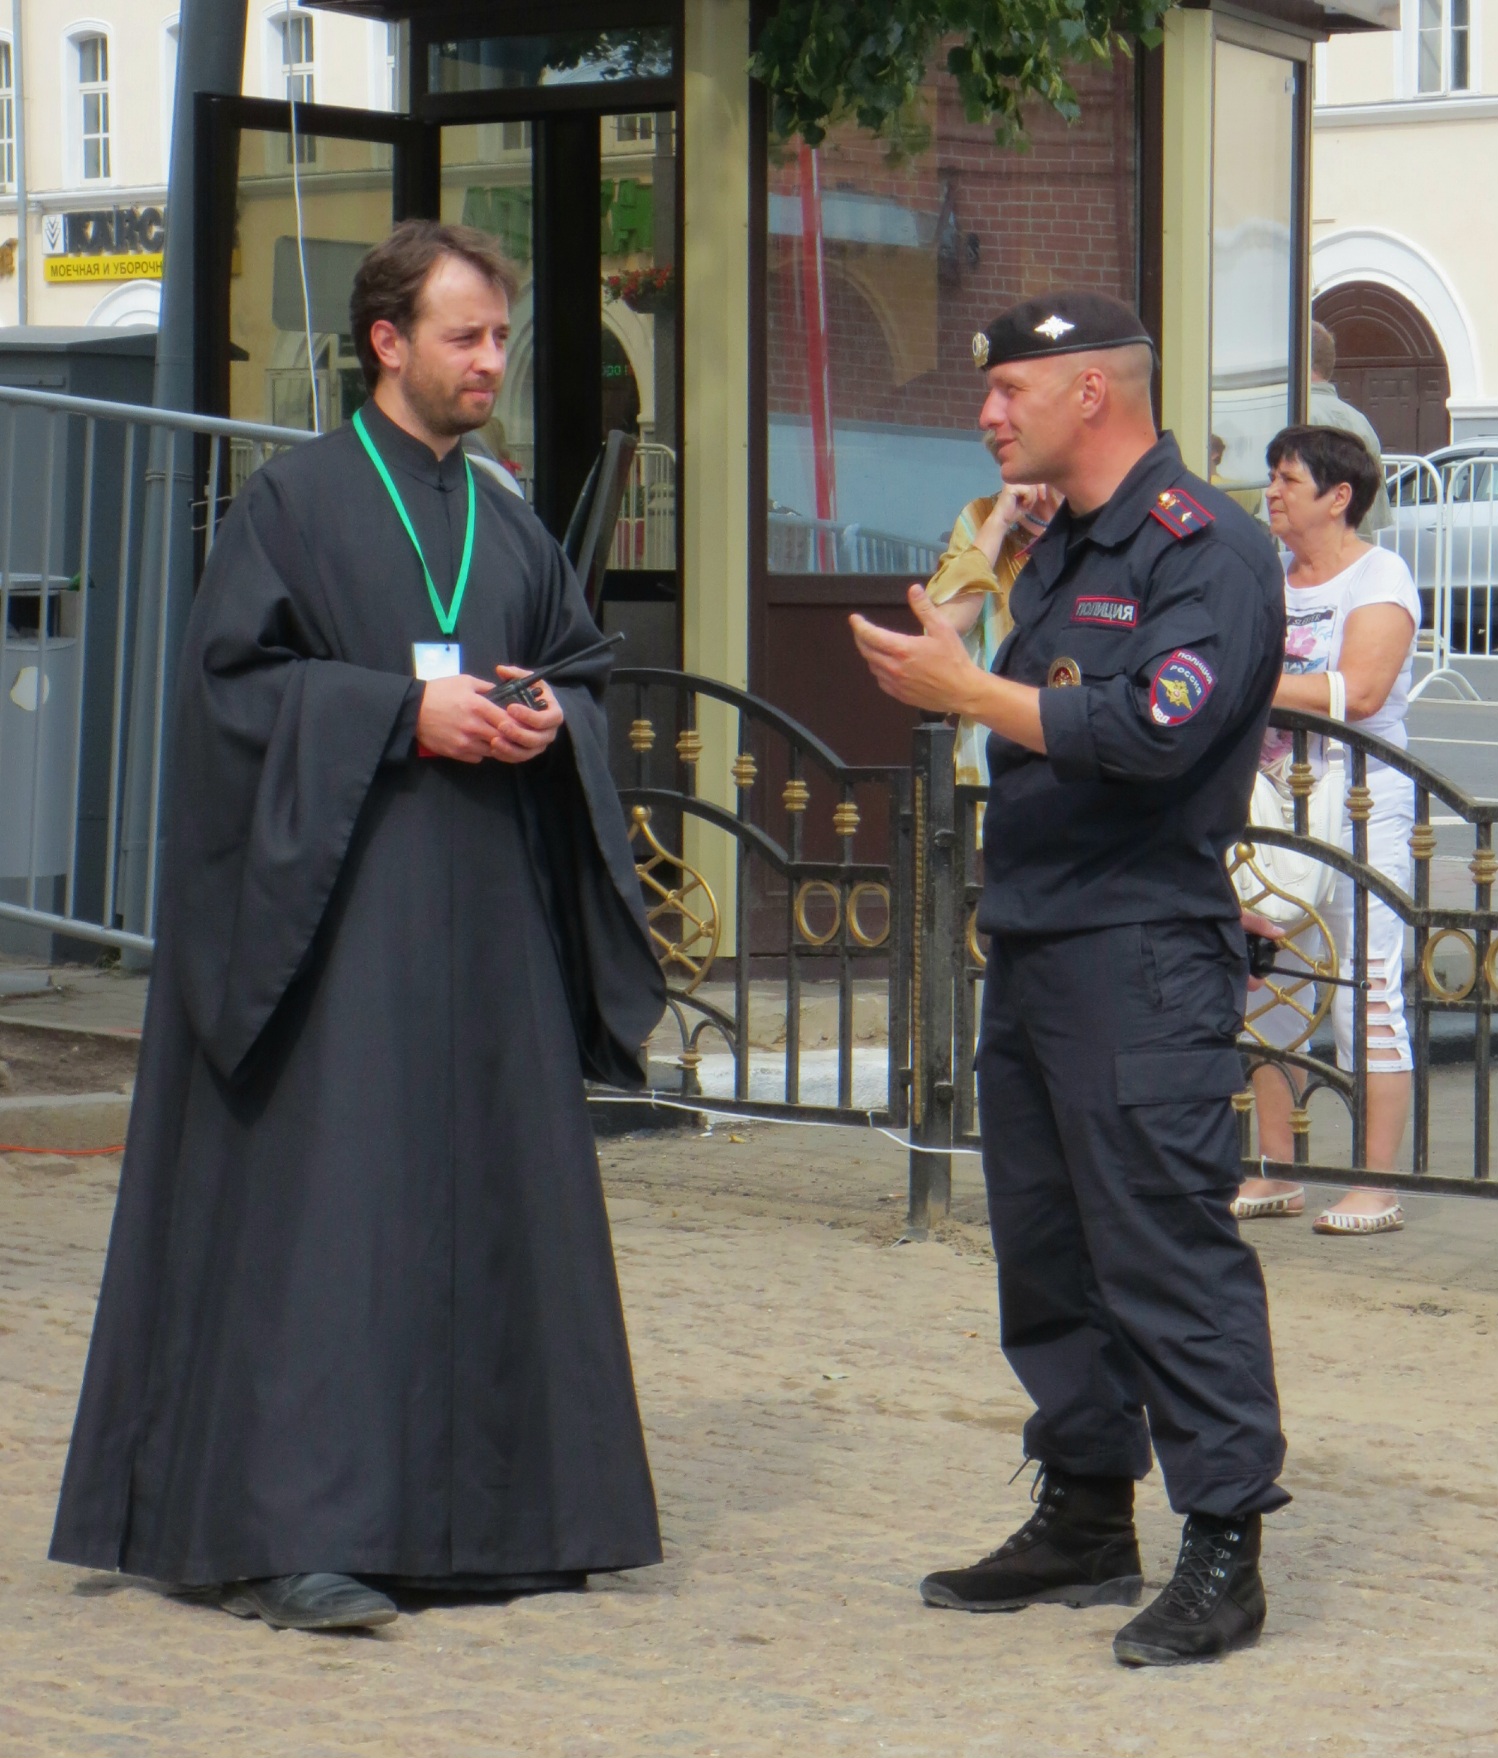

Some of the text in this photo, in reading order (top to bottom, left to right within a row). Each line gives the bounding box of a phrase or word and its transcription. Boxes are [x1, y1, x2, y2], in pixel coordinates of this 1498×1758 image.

[50, 262, 100, 277] МОЕЧНАЯ
[103, 262, 110, 275] И
[1075, 601, 1135, 621] ПОЛИЦИЯ
[1169, 664, 1202, 696] РОССИЯ
[1177, 651, 1213, 684] ПОЛИЦИЯ
